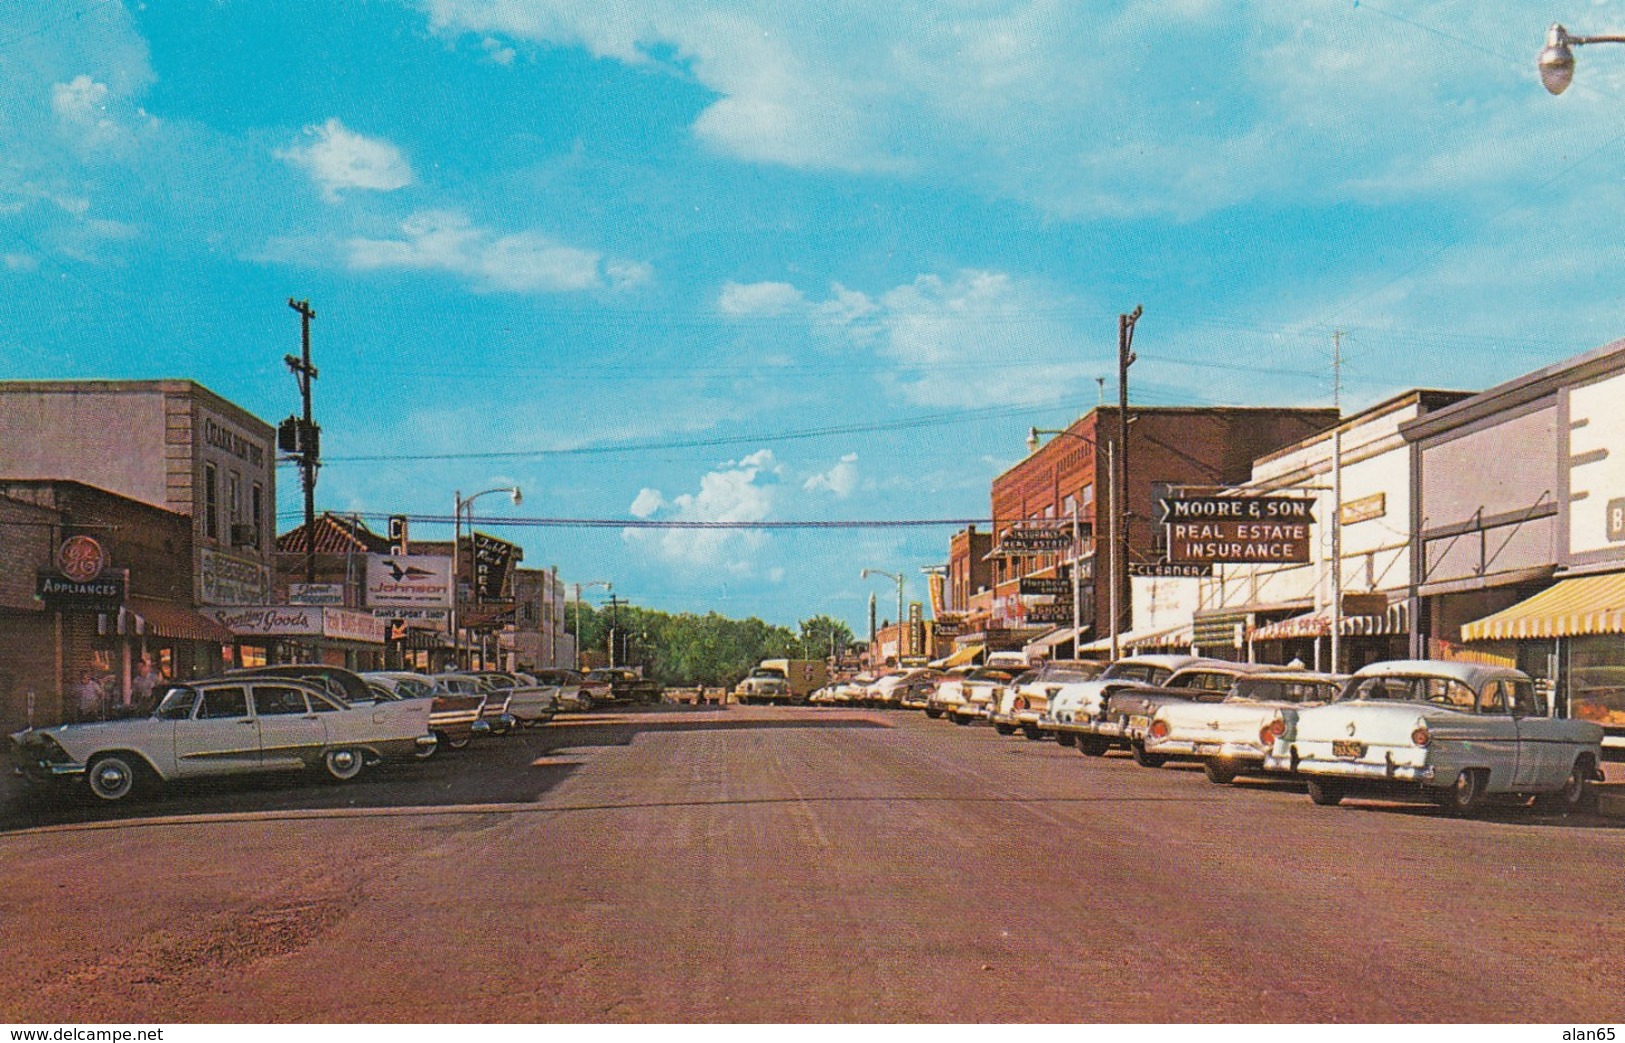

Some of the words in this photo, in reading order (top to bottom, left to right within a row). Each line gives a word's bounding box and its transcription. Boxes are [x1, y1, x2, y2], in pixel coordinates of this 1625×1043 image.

[1175, 502, 1242, 516] MOORE
[1249, 502, 1260, 518] &
[1267, 502, 1305, 516] SON
[1176, 525, 1224, 539] REAL
[1237, 525, 1304, 539] ESTATE
[1186, 542, 1294, 557] INSURANCE
[43, 578, 117, 596] APPLIANCES
[369, 583, 447, 594] Johnson
[215, 610, 265, 629] Sporting
[261, 610, 310, 632] Goods
